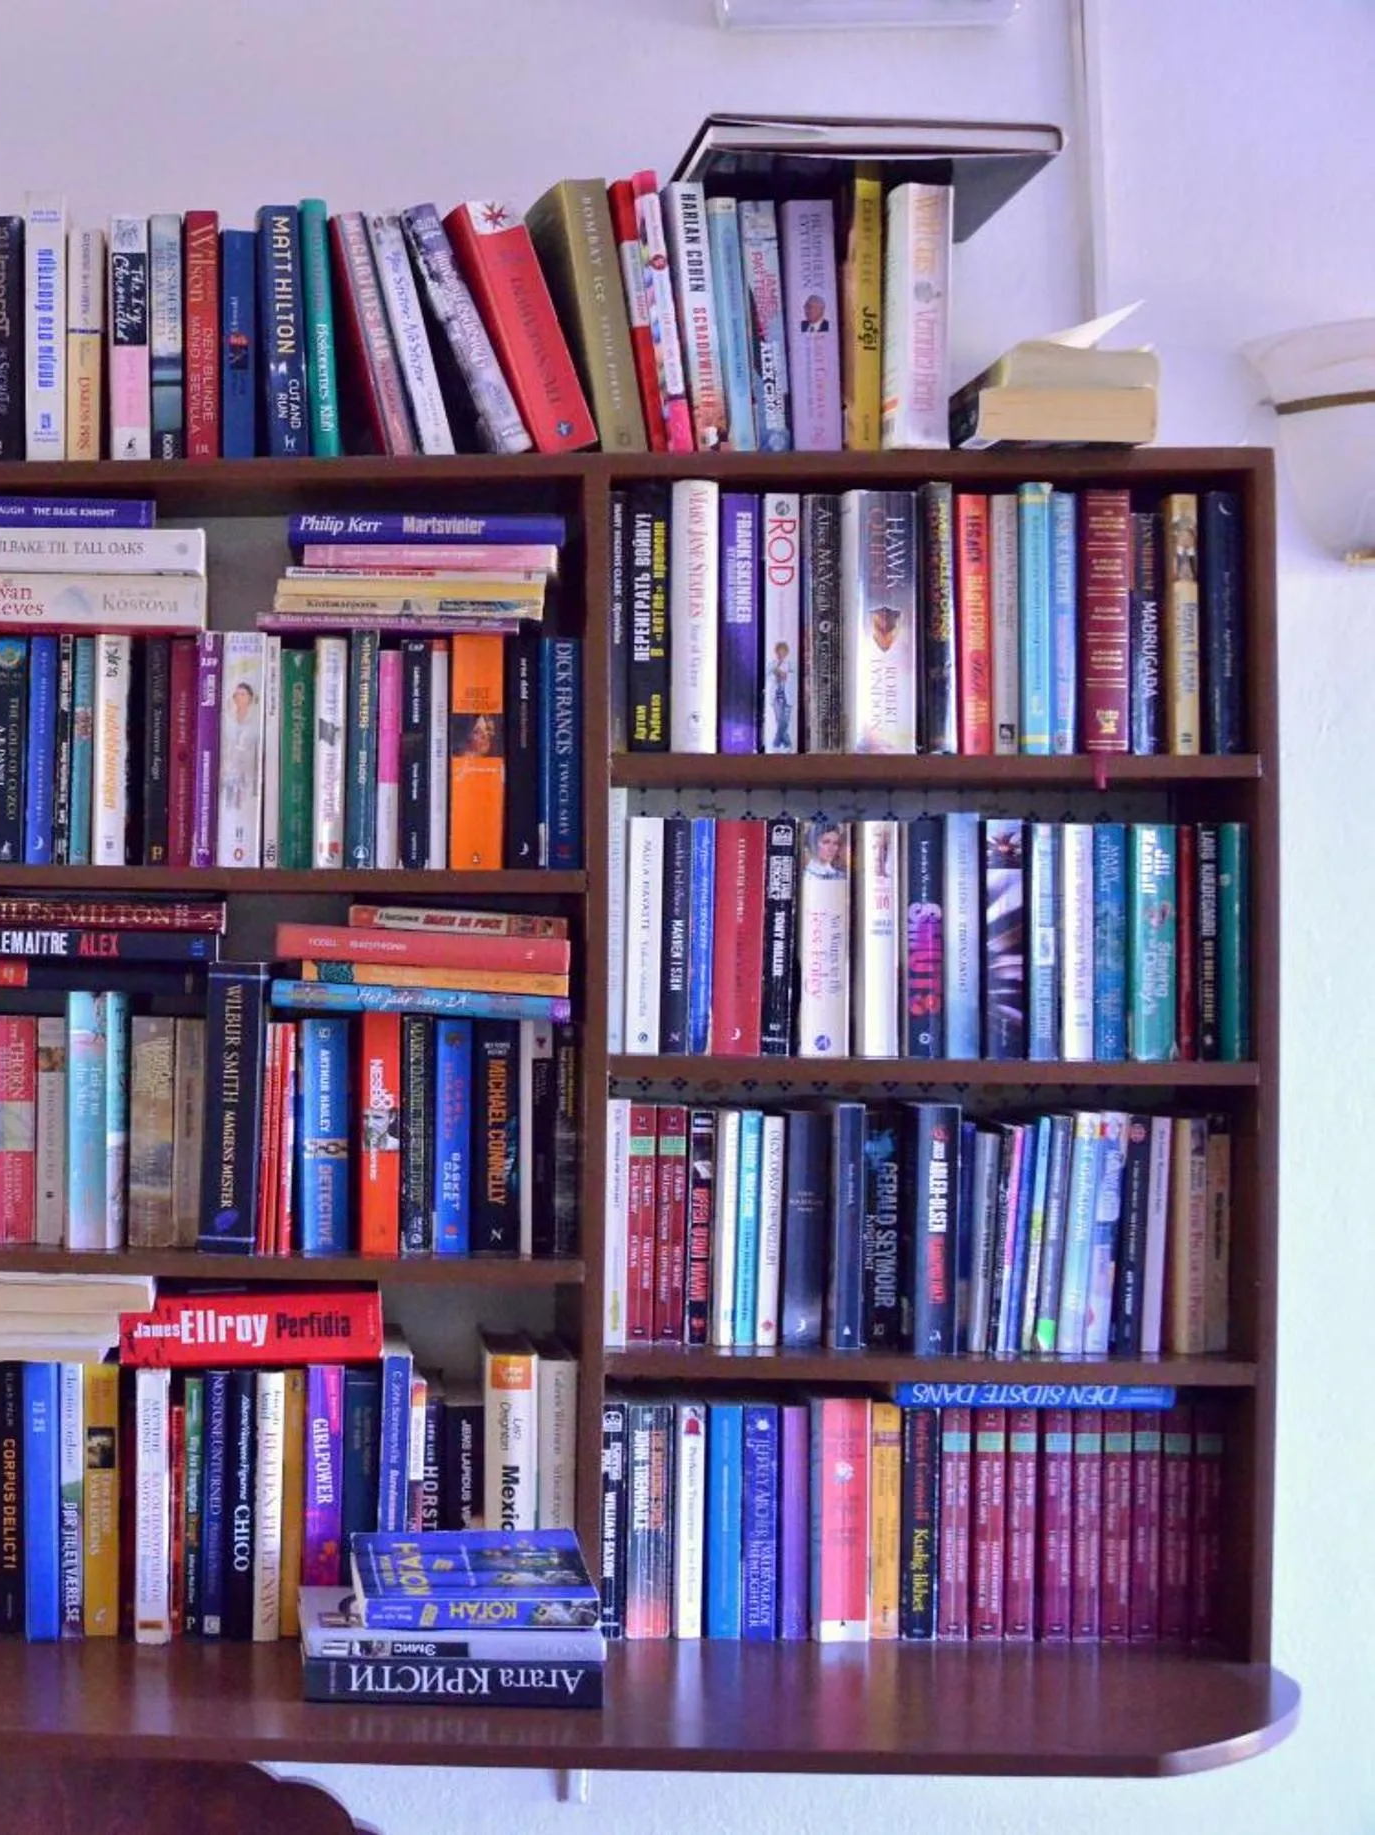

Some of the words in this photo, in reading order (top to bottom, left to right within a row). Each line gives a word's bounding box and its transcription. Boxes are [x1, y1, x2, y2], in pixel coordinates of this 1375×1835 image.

[270, 215, 293, 274] MATT
[680, 192, 701, 245] HARLAN
[189, 220, 215, 303] Wilson
[685, 249, 706, 293] COBEN
[201, 326, 214, 359] DEN
[275, 277, 297, 354] HILTON
[202, 365, 215, 423] BLINDE
[276, 392, 289, 420] RUN
[288, 378, 300, 401] CUT
[289, 402, 302, 430] AND
[73, 541, 106, 555] TALL
[107, 542, 145, 556] OAKS
[299, 516, 345, 536] Philip
[347, 517, 382, 533] Kerr
[736, 512, 753, 559] FRANK
[767, 517, 797, 588] ROD
[885, 516, 906, 589] HAWK
[736, 560, 753, 623] SKINNER
[555, 641, 574, 685] DICK
[1140, 600, 1158, 698] MADRUGADA
[555, 686, 574, 755] FRANCIS
[78, 932, 120, 957] ALEX
[223, 983, 244, 1046] WILBUR
[223, 1051, 241, 1103] SMITH
[486, 1058, 507, 1125] MICHAEL
[219, 1162, 236, 1208] MESTER
[487, 1128, 507, 1206] CONNELLY
[875, 1161, 898, 1225] GERALD
[316, 1162, 334, 1246] DETECTIVE
[874, 1229, 897, 1308] SEYMOUR
[133, 1321, 180, 1340] James
[180, 1309, 269, 1349] Ellroy
[275, 1311, 352, 1340] Perfidia
[912, 1383, 976, 1405] DANS
[980, 1384, 1066, 1406] SIDSTE
[1065, 1384, 1119, 1406] DEN
[2, 1437, 16, 1501] CORPUS
[2, 1505, 17, 1569] DELICTI
[232, 1504, 251, 1573] CHICO
[64, 1566, 80, 1622] VÆRELSE
[347, 1664, 491, 1695] КРИСТИ
[498, 1667, 586, 1695] Агата
